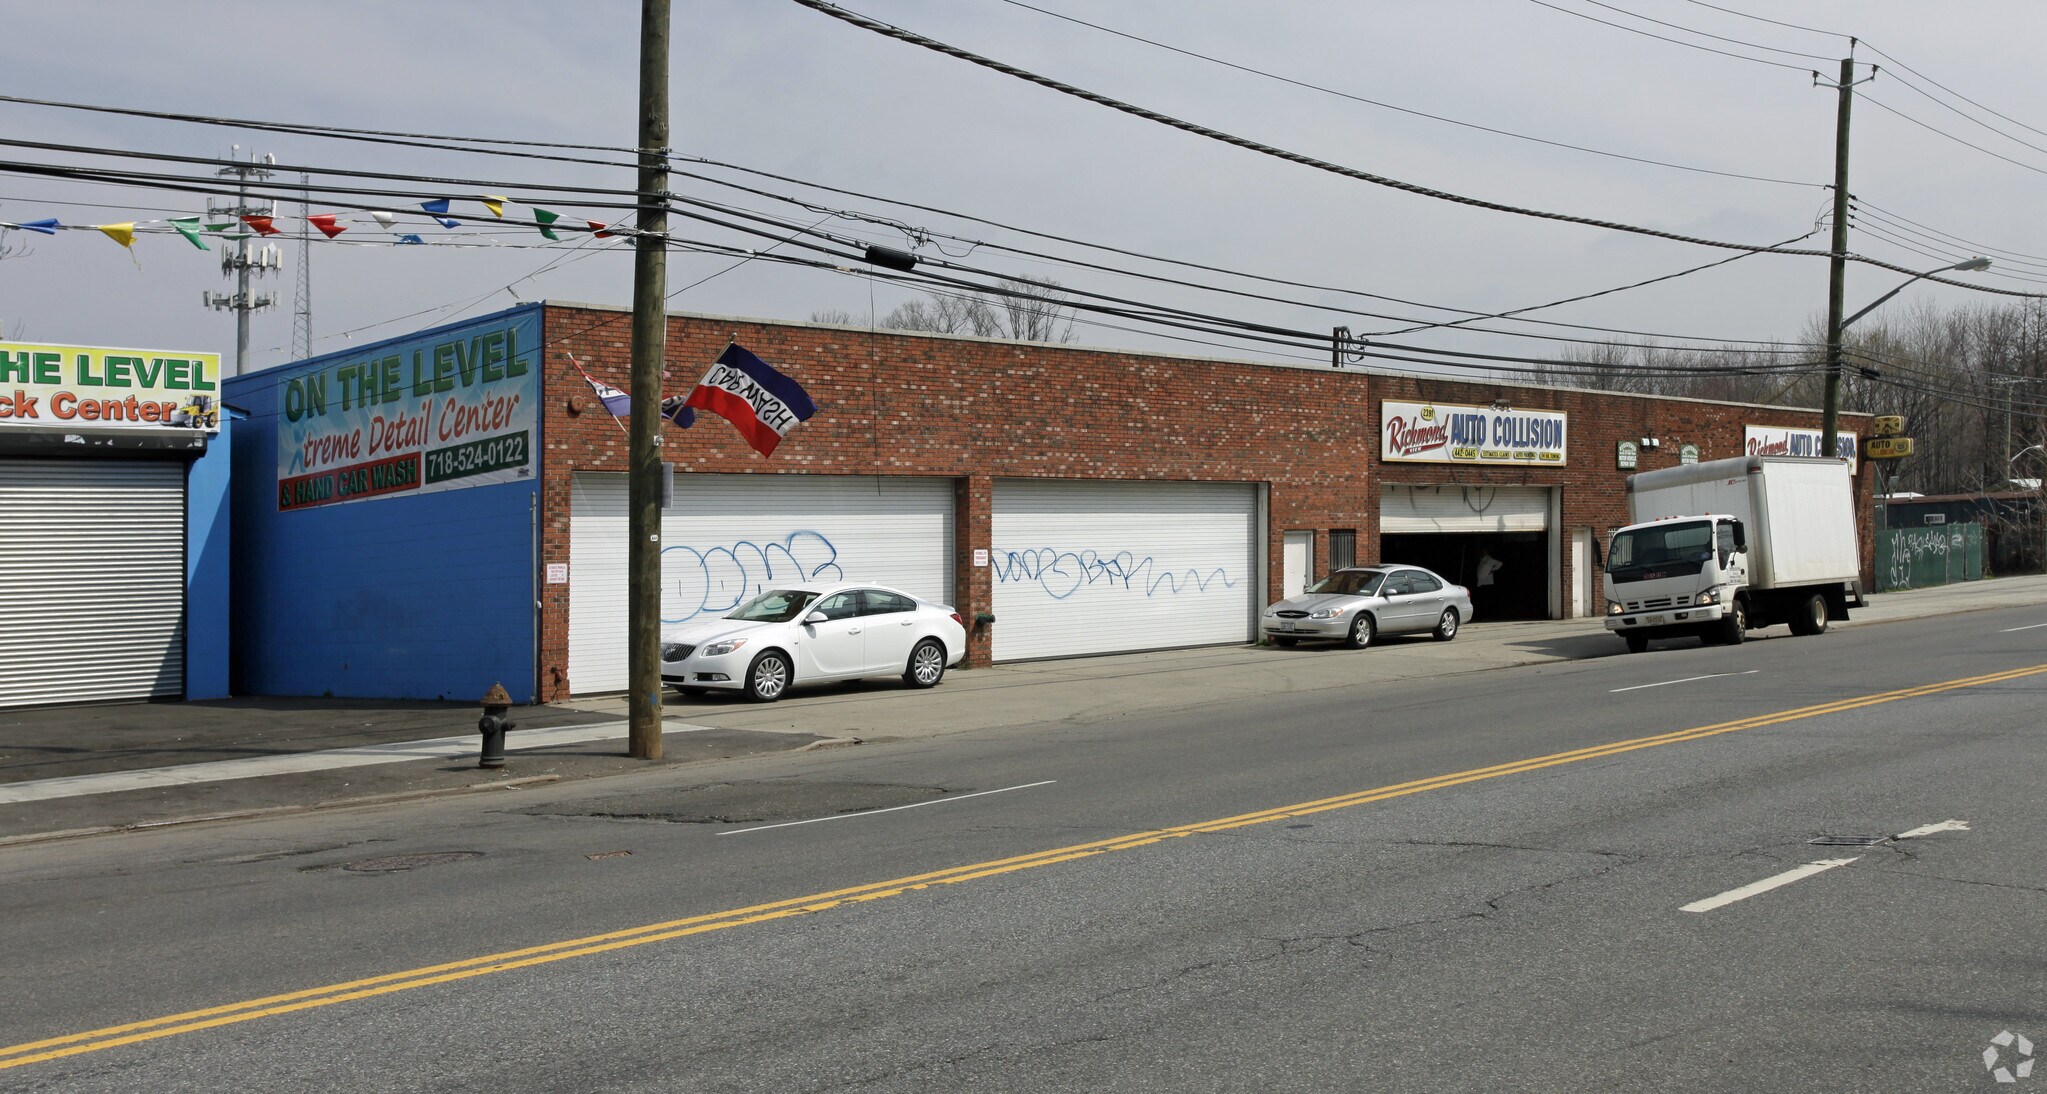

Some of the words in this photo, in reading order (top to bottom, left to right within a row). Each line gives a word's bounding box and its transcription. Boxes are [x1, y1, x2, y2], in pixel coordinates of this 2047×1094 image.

[77, 354, 216, 391] LEVEL
[285, 370, 327, 422] ON
[337, 354, 402, 411] THE
[412, 327, 528, 397] LEVEL
[50, 390, 177, 421] Center
[368, 398, 433, 456] Detail
[437, 390, 520, 442] Center
[1387, 414, 1450, 454] Richmond
[1450, 413, 1487, 446] AUTO
[1493, 416, 1562, 449] COLLISION
[1454, 447, 1476, 458] 442-0445
[1790, 433, 1812, 457] AUTO
[1871, 440, 1890, 449] AUTO
[428, 436, 523, 477] 718-524-0122
[280, 481, 292, 507] &
[294, 471, 334, 505] HAND
[337, 466, 368, 495] CAR
[371, 457, 417, 491] WASH
